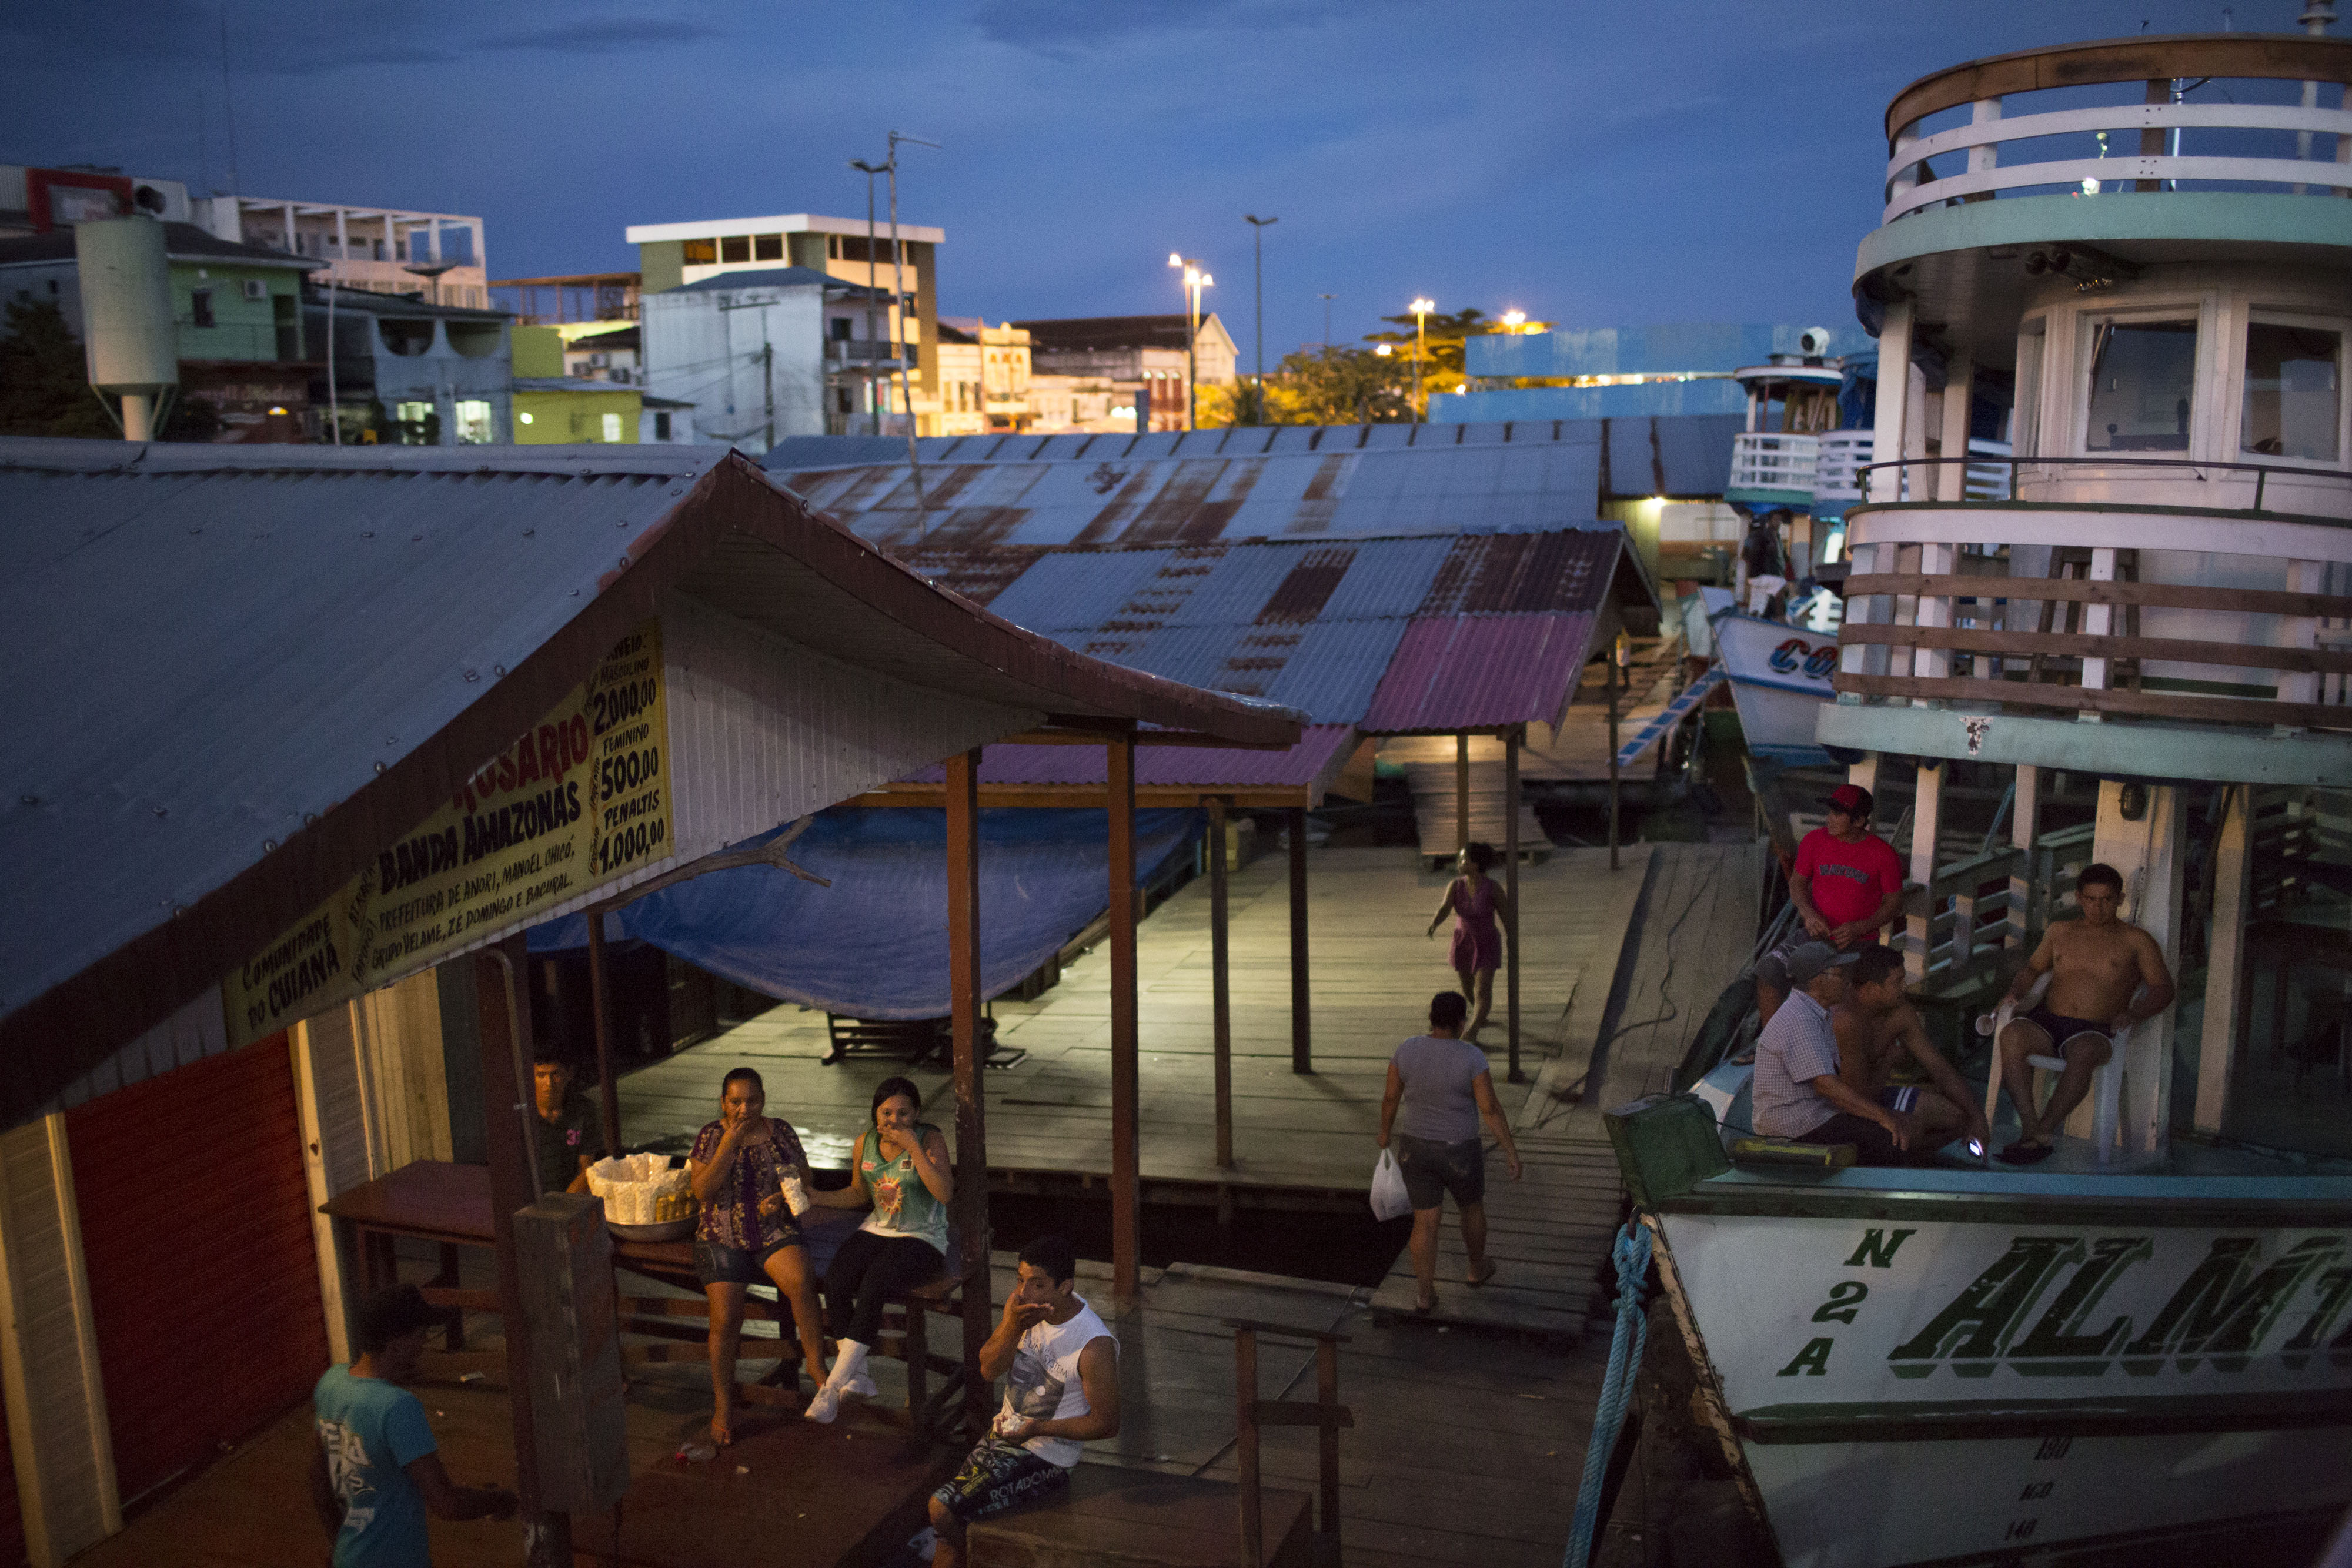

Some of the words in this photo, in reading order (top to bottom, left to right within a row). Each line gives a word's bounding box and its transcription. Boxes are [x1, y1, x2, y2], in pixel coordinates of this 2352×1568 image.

[1769, 638, 1839, 682] CO
[603, 723, 649, 757] FEMININO
[601, 747, 659, 801] 500,00
[379, 825, 459, 895] BANDA
[463, 781, 582, 866] AMAZONAS
[604, 789, 660, 830] PENALTIS
[599, 818, 664, 875] 1.000,00
[380, 888, 445, 932] PREFEITURA
[448, 884, 462, 909] DE
[464, 871, 501, 900] ANORI,
[502, 853, 542, 885] MANOEL
[243, 912, 333, 991] COMUNIDADE
[372, 941, 403, 970] GRUPO
[448, 910, 463, 937] ZÉ
[466, 897, 513, 929] DOMINGO
[516, 891, 523, 907] E
